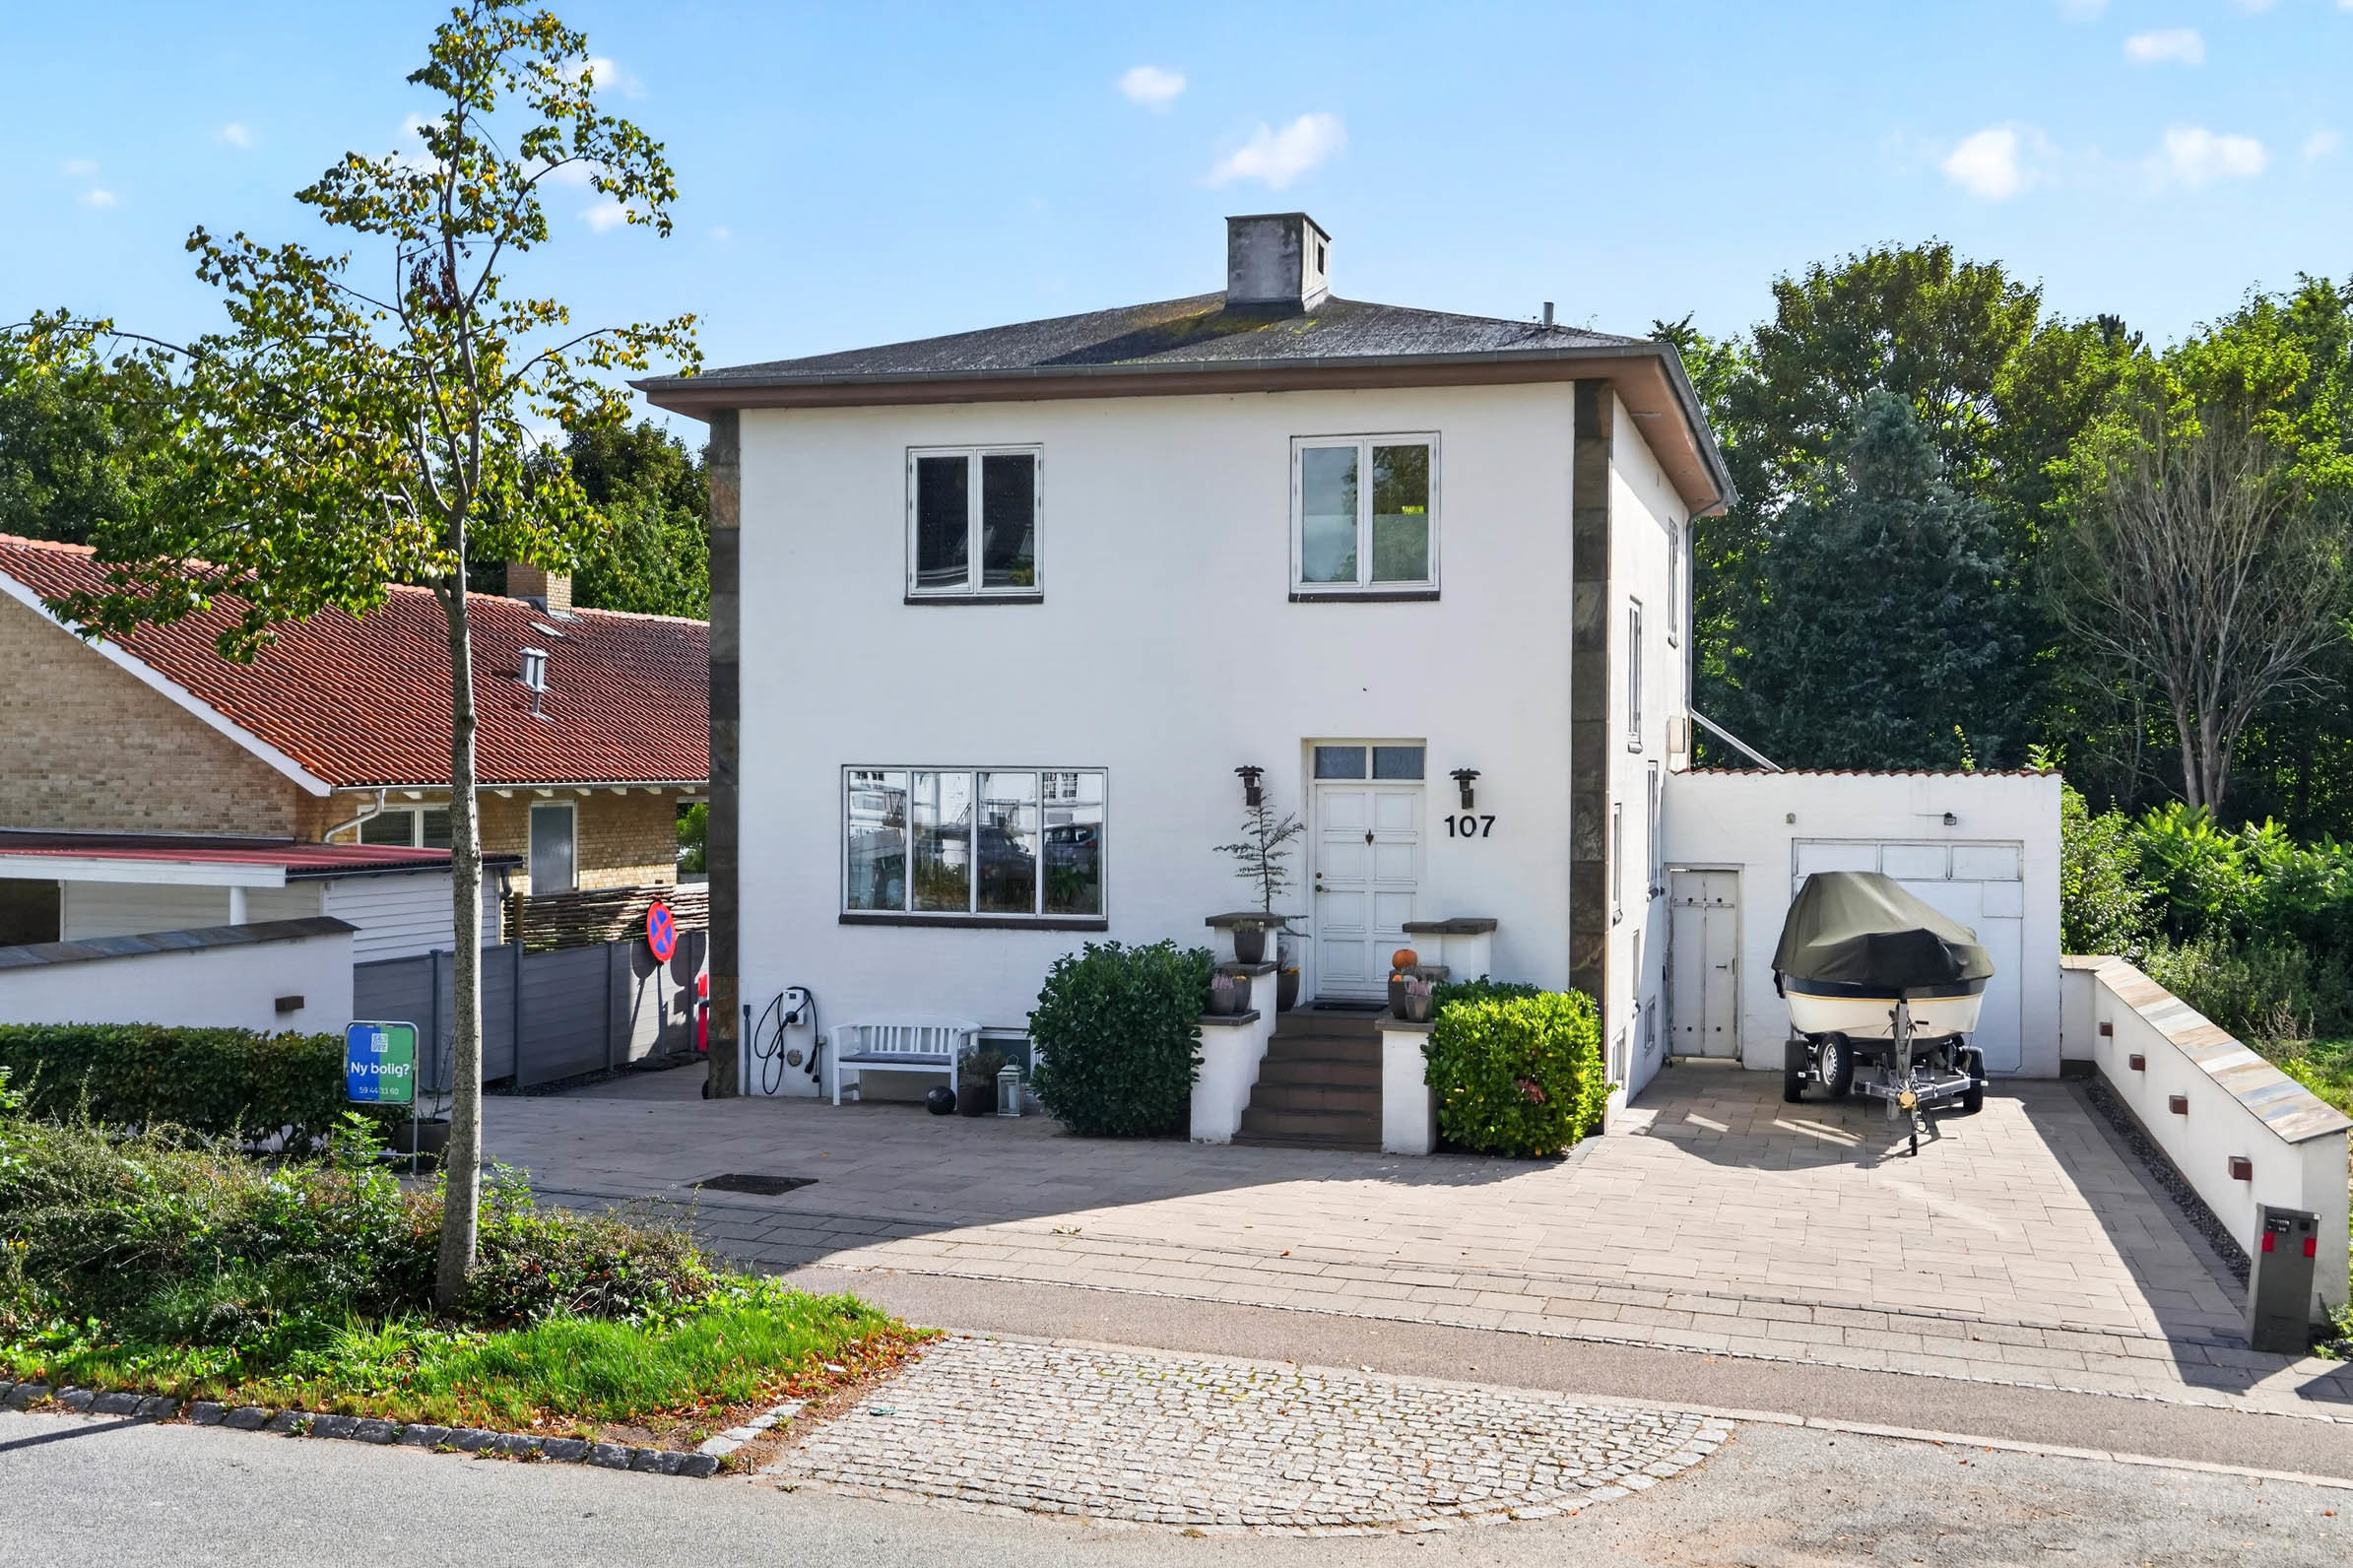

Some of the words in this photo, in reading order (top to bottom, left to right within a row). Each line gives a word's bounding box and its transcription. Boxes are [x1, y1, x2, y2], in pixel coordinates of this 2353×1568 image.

[1444, 816, 1496, 838] 107
[351, 1062, 368, 1077] Ny
[370, 1062, 411, 1078] bolig?
